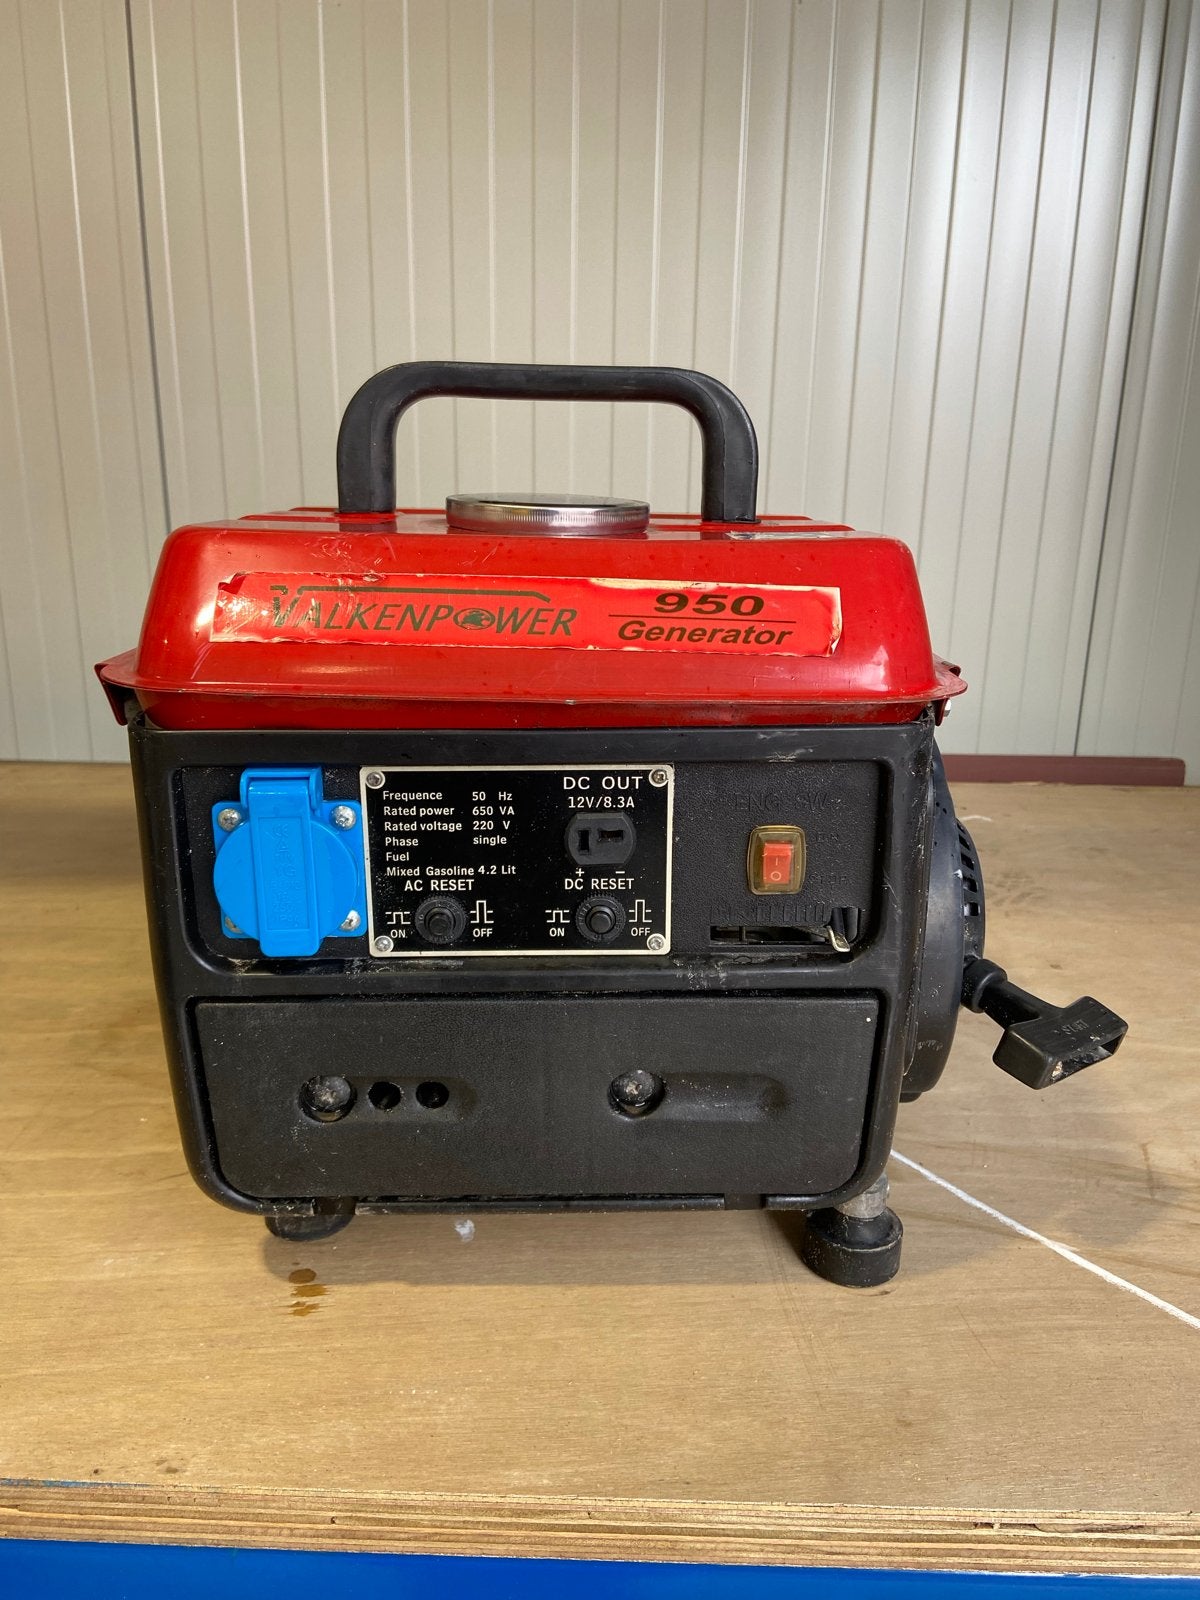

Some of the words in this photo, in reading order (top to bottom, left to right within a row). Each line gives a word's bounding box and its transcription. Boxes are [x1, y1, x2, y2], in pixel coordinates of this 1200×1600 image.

[654, 592, 765, 617] 950
[618, 620, 794, 646] Generator
[563, 776, 590, 790] DC
[601, 776, 643, 790] OUT
[382, 790, 443, 801] Frequence
[472, 791, 486, 801] 50
[498, 791, 513, 801] Hz
[568, 796, 635, 809] 12V/8.3A
[383, 805, 417, 816] Rated
[419, 806, 455, 818] power
[472, 805, 494, 816] 650
[499, 806, 515, 816] VA
[384, 821, 417, 832] Rated
[419, 820, 463, 833] voltage
[472, 820, 494, 831] 220
[502, 820, 511, 830] V
[385, 836, 419, 847] Phase
[473, 834, 507, 846] single
[385, 851, 410, 862] Fuel
[386, 866, 420, 877] Mixed
[425, 865, 475, 876] Gasoline
[477, 864, 497, 875] 4.2
[501, 864, 516, 875] Lit
[404, 879, 423, 892] AC
[430, 879, 475, 892] RESET
[564, 878, 584, 890] DC
[591, 878, 635, 890] RESET
[390, 929, 407, 939] ON
[472, 927, 493, 938] OFF
[549, 927, 565, 937] ON
[630, 926, 651, 937] OFF
